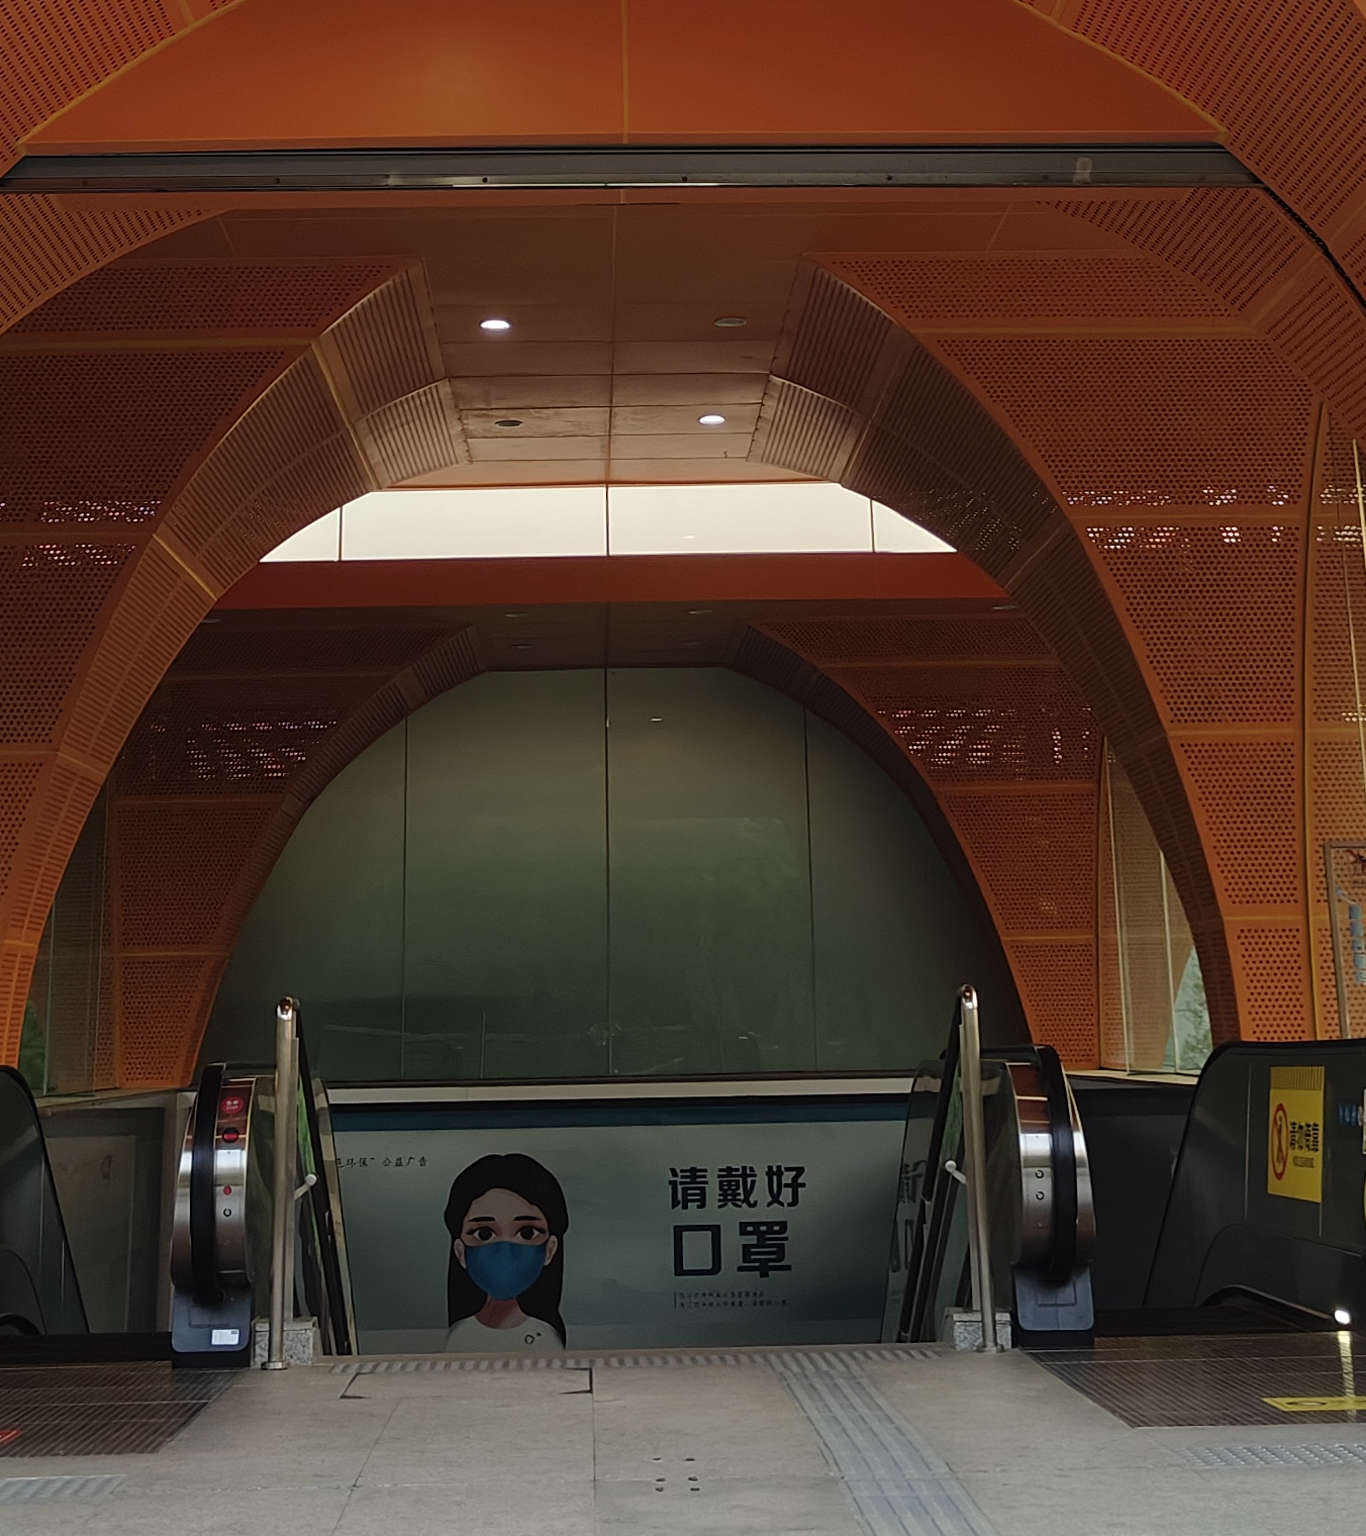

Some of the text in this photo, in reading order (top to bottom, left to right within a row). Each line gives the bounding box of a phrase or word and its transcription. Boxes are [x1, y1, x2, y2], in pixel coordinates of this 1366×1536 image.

[668, 1165, 806, 1210] 请戴好
[673, 1221, 792, 1278] 口罩
